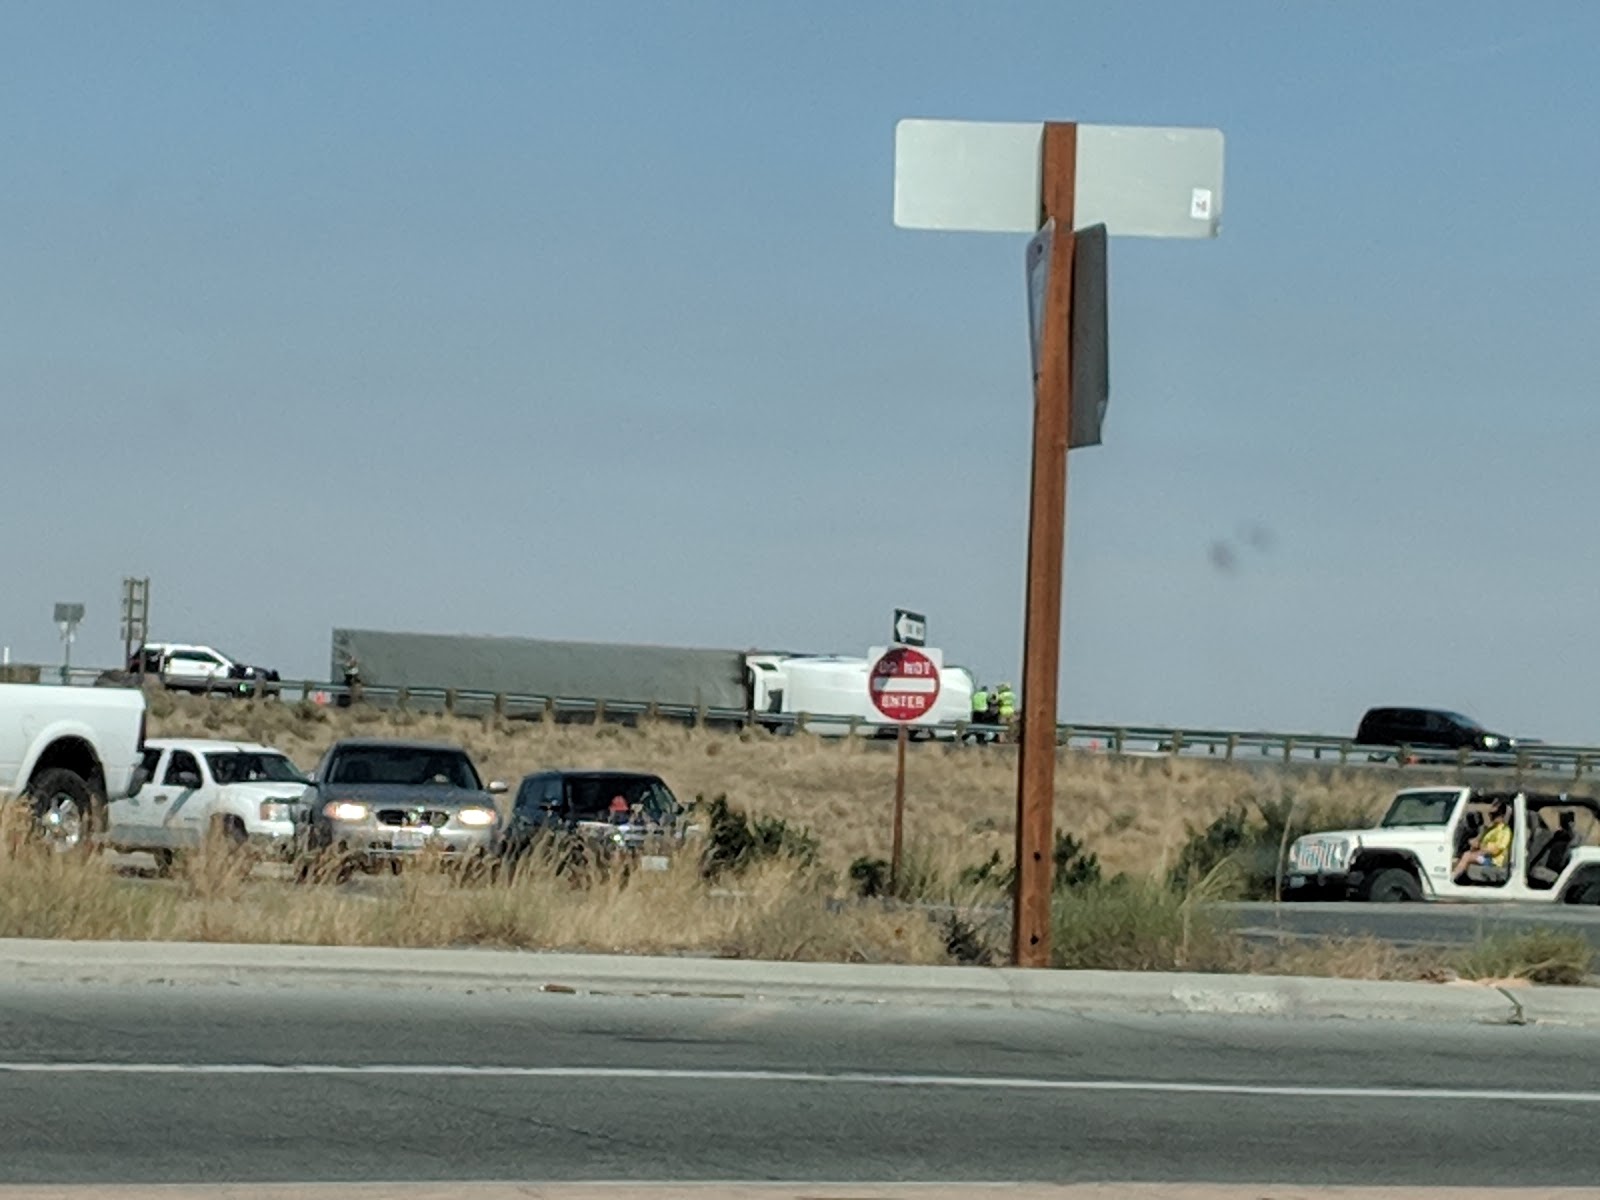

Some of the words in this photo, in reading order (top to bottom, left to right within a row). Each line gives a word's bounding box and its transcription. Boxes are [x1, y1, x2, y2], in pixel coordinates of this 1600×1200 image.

[879, 661, 898, 673] DO
[903, 661, 930, 675] NOT
[881, 695, 925, 709] ENTER
